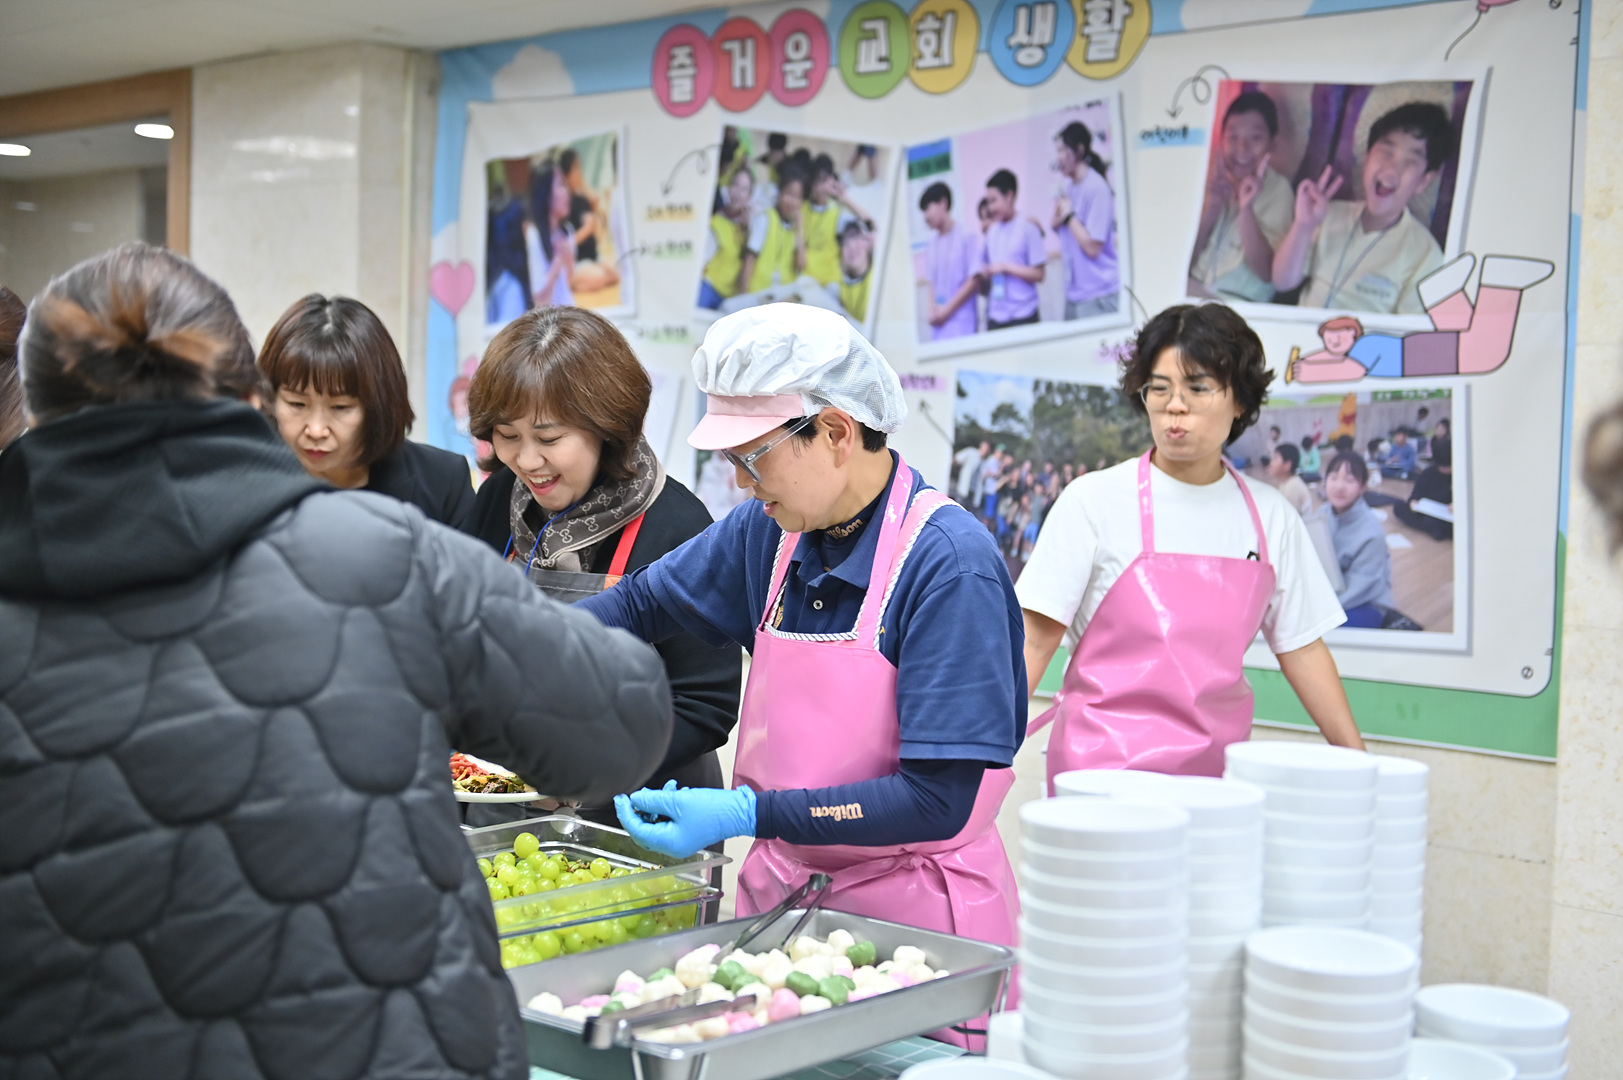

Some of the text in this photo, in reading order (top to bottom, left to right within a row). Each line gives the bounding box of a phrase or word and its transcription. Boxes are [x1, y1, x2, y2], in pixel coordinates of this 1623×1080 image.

[667, 0, 1133, 104] 즐거운 교회 생활
[826, 518, 863, 540] Wilson
[809, 802, 864, 822] Wilson
